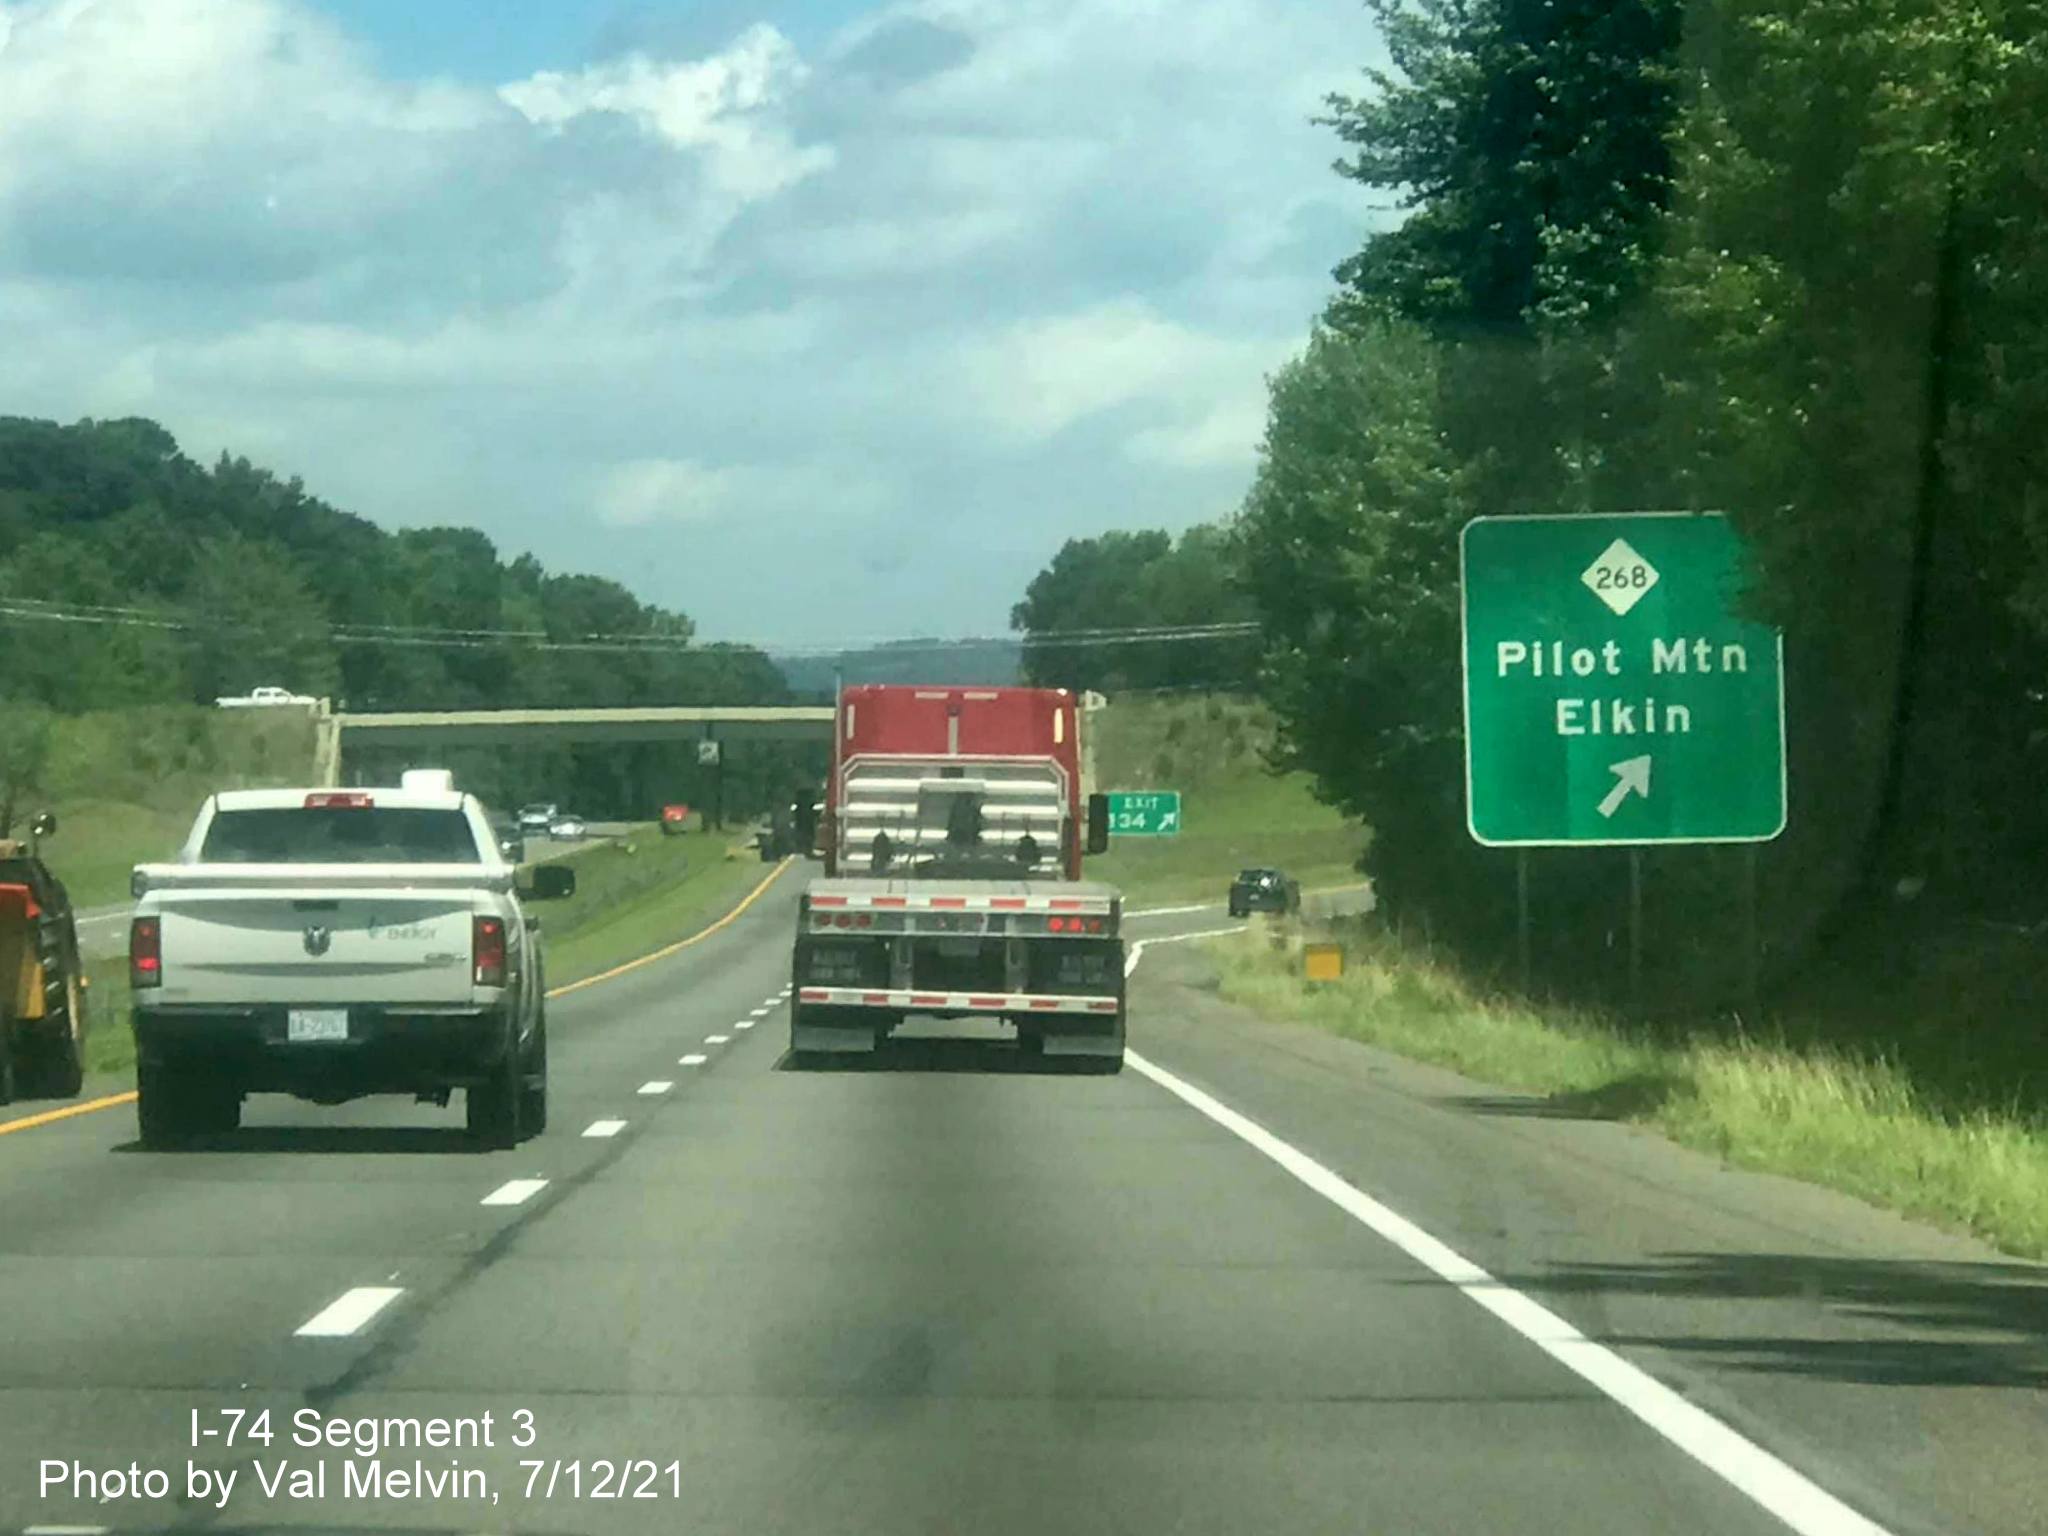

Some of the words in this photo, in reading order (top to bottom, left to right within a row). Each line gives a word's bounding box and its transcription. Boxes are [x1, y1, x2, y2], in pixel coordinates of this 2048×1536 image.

[1596, 566, 1648, 589] 268
[1497, 640, 1621, 677] Pilot
[1652, 637, 1747, 674] Mtn
[1556, 698, 1691, 735] Elkin
[1124, 797, 1158, 810] EXIT
[1108, 813, 1146, 829] 134
